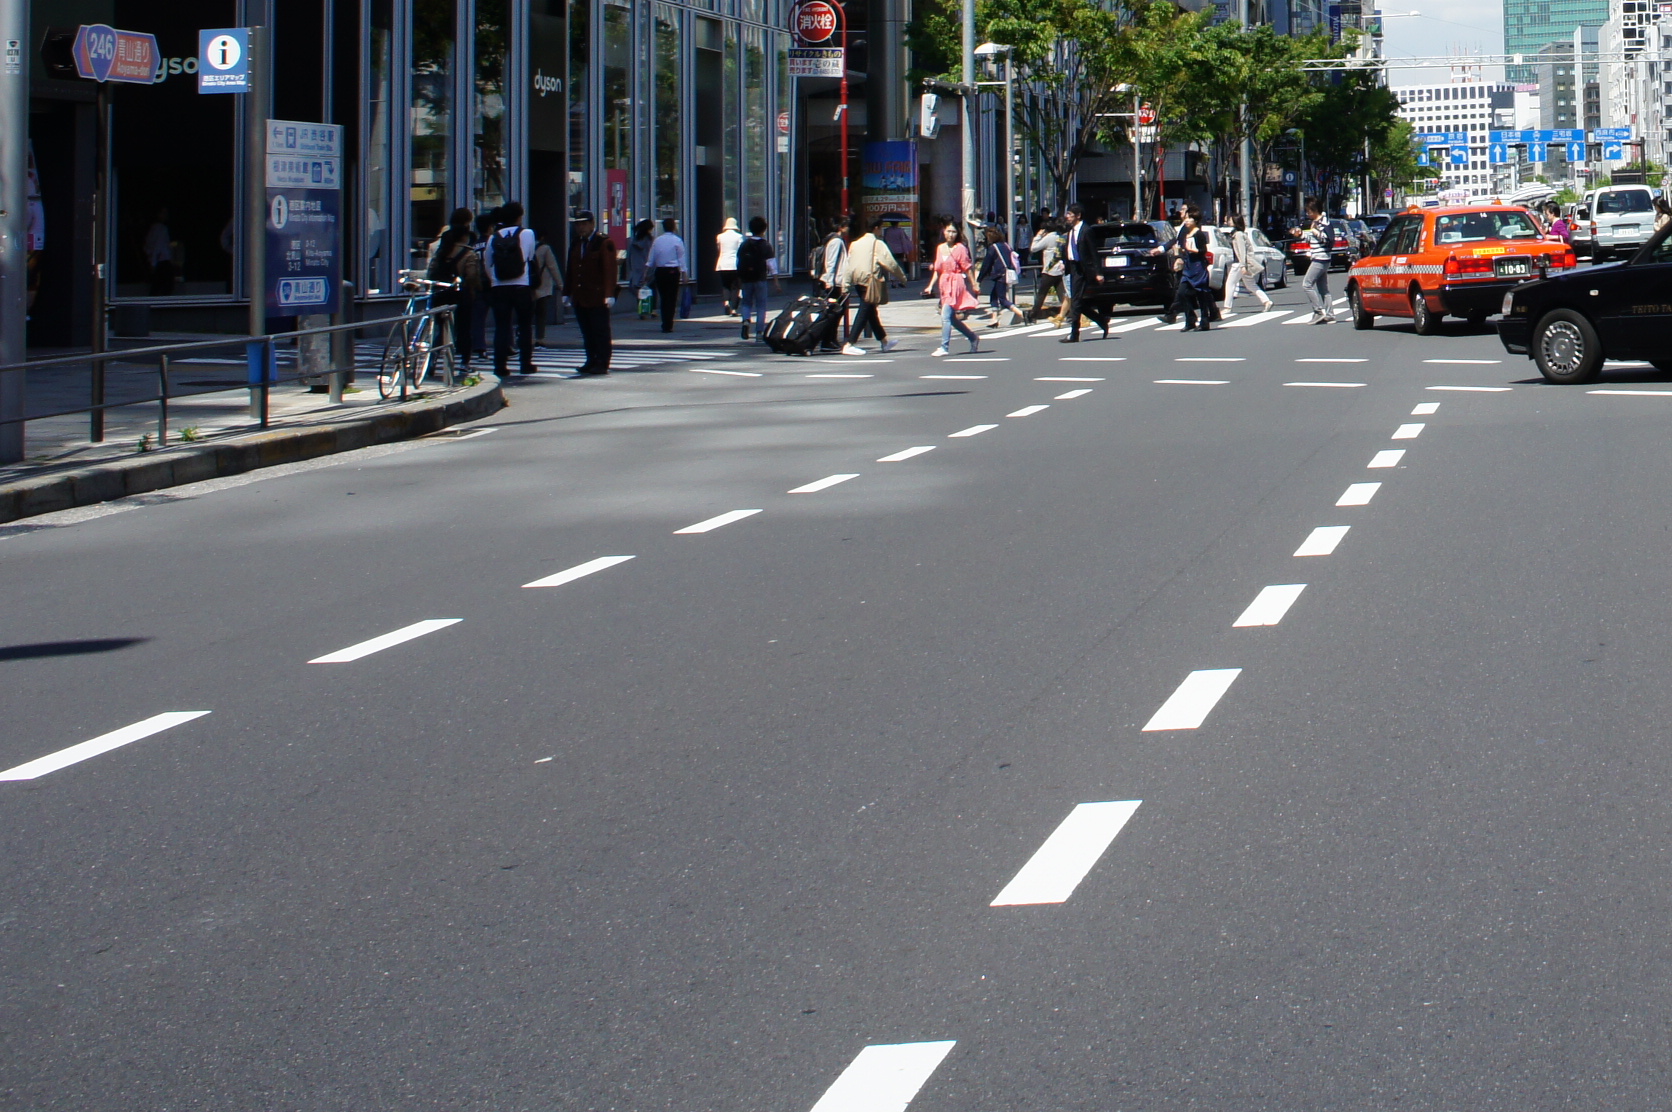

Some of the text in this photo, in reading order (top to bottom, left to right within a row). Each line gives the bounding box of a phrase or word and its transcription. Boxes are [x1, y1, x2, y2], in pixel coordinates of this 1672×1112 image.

[799, 13, 833, 30] 消火栓
[90, 32, 113, 61] 246
[117, 39, 150, 63] 青山通り
[534, 68, 563, 98] dyson
[1631, 304, 1659, 315] TEITO
